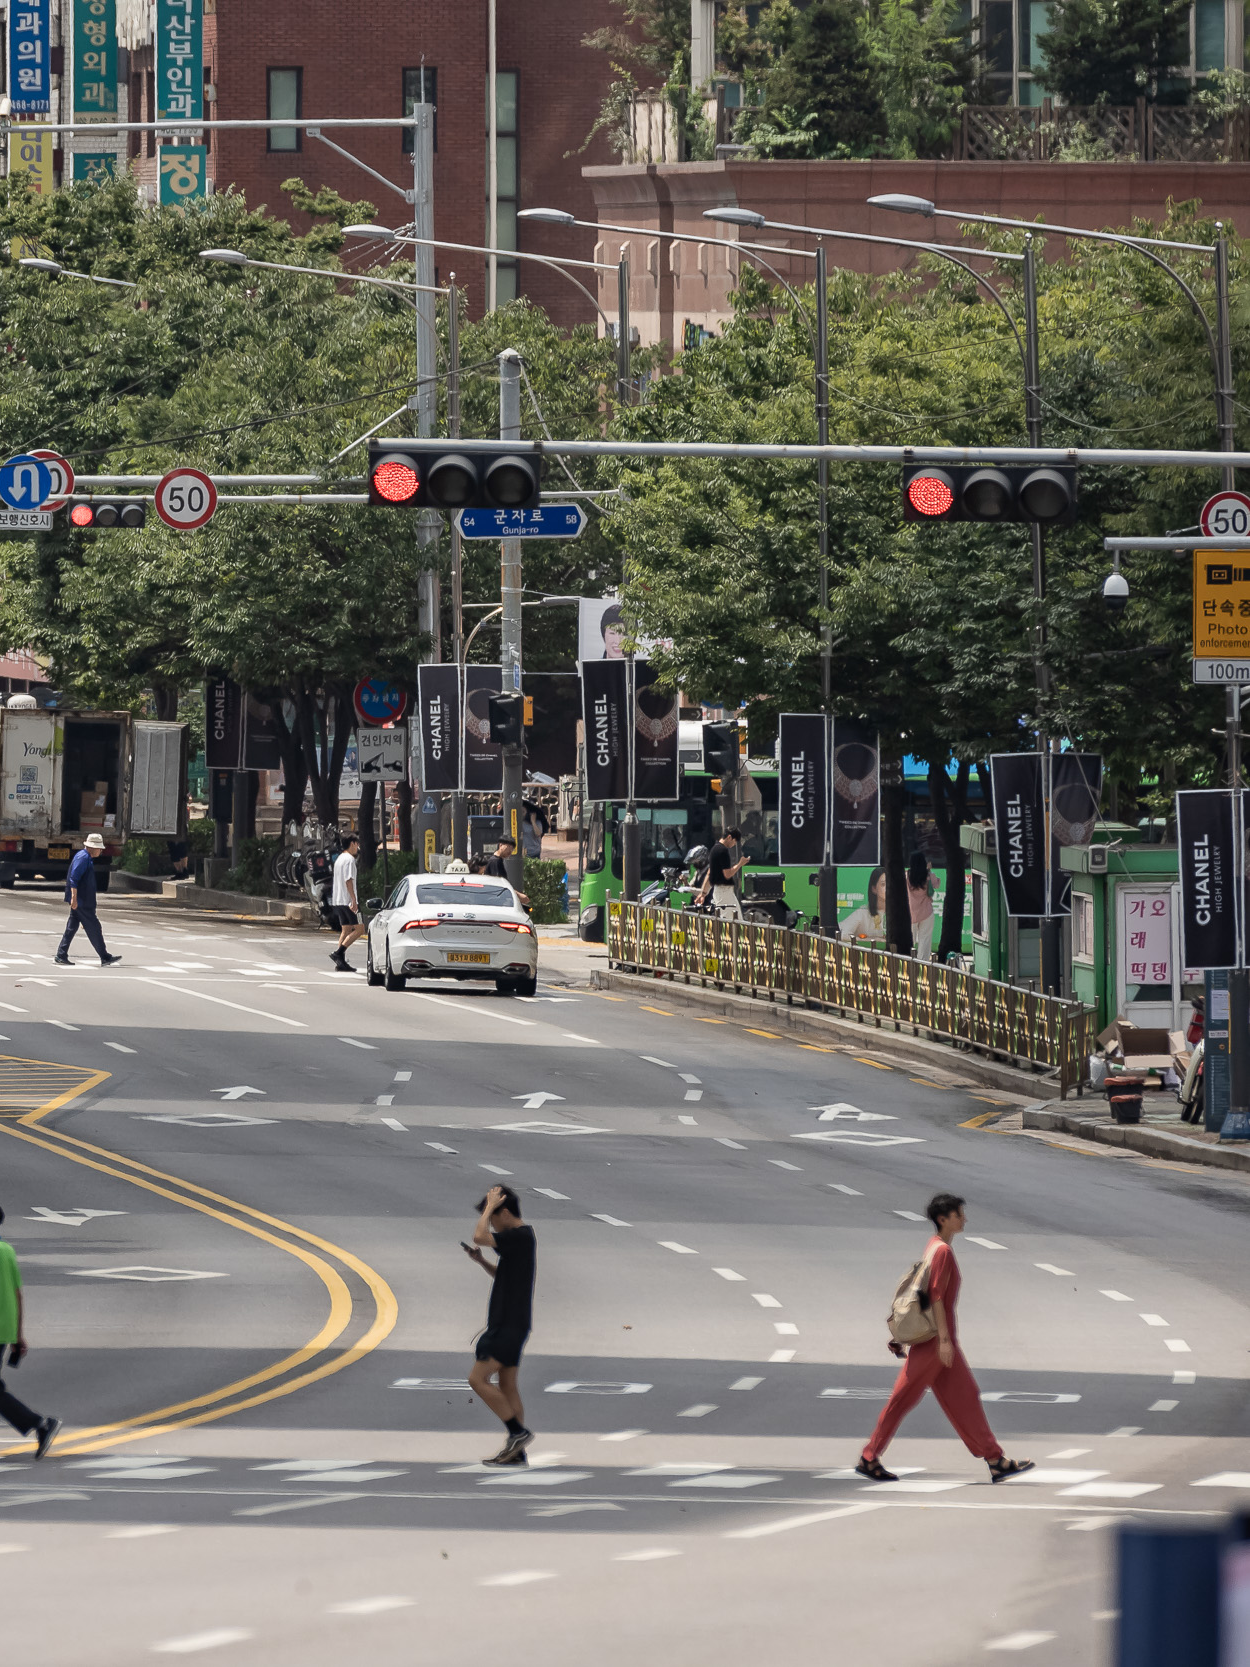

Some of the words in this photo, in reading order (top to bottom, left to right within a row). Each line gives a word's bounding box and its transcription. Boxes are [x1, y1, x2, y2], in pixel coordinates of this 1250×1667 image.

[15, 0, 43, 91] 과의원
[169, 487, 205, 513] 50
[463, 518, 475, 526] 54
[494, 509, 545, 524] 군자로
[565, 515, 577, 524] 58
[1213, 508, 1248, 534] 50
[502, 526, 540, 536] Gunja-ro
[1202, 599, 1250, 617] 단속중
[1208, 623, 1248, 635] Photo
[1208, 664, 1250, 680] 100m
[214, 681, 225, 740] CHANEL
[610, 702, 619, 735] JEWELRY
[361, 735, 403, 746] 견인지역
[430, 695, 442, 760] CHANEL
[595, 694, 610, 767] CHANEL
[611, 736, 619, 757] HIGH
[791, 751, 805, 829] CHANEL
[1007, 794, 1024, 878] CHANEL
[1025, 804, 1033, 842] JEWELRY
[1213, 845, 1223, 885] JEWELRY
[1194, 834, 1211, 926] CHANEL
[1215, 887, 1223, 913] HIGH
